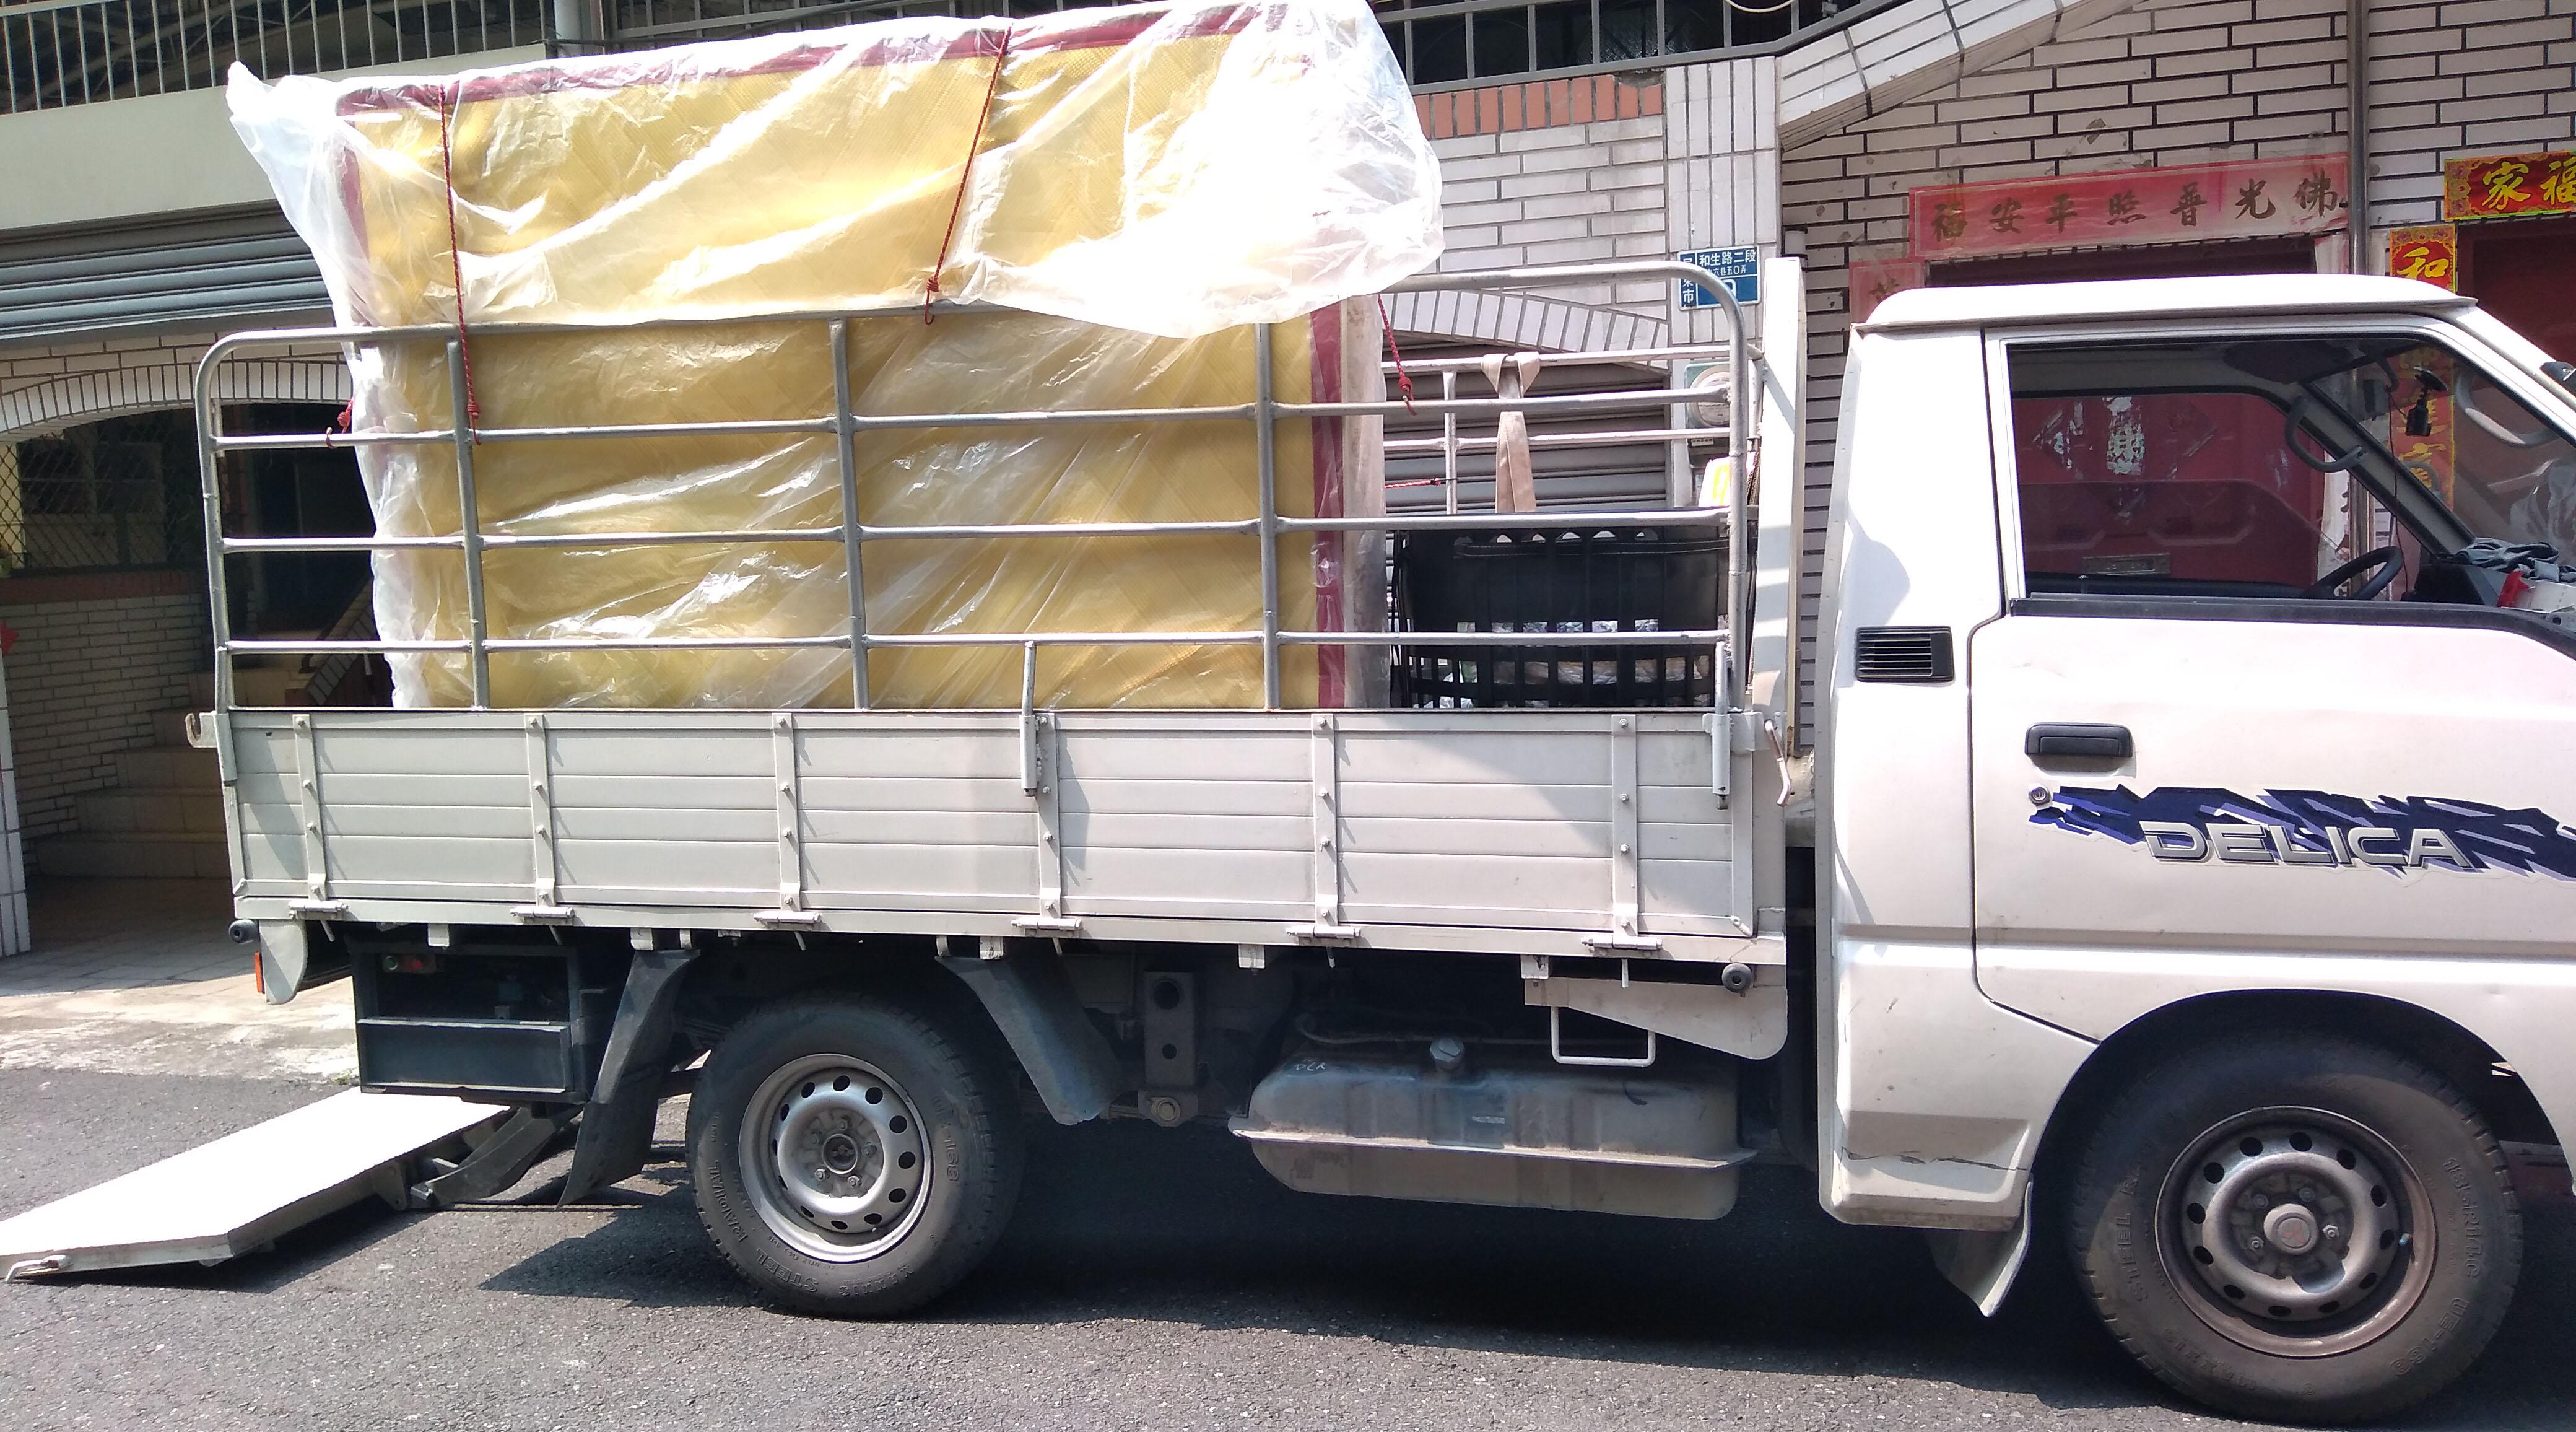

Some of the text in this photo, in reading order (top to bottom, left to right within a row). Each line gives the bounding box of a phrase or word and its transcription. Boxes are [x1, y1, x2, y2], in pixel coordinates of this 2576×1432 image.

[1699, 249, 1756, 267] 和生路二段
[2139, 821, 2476, 868] DELICA
[756, 1247, 819, 1292] STEEL
